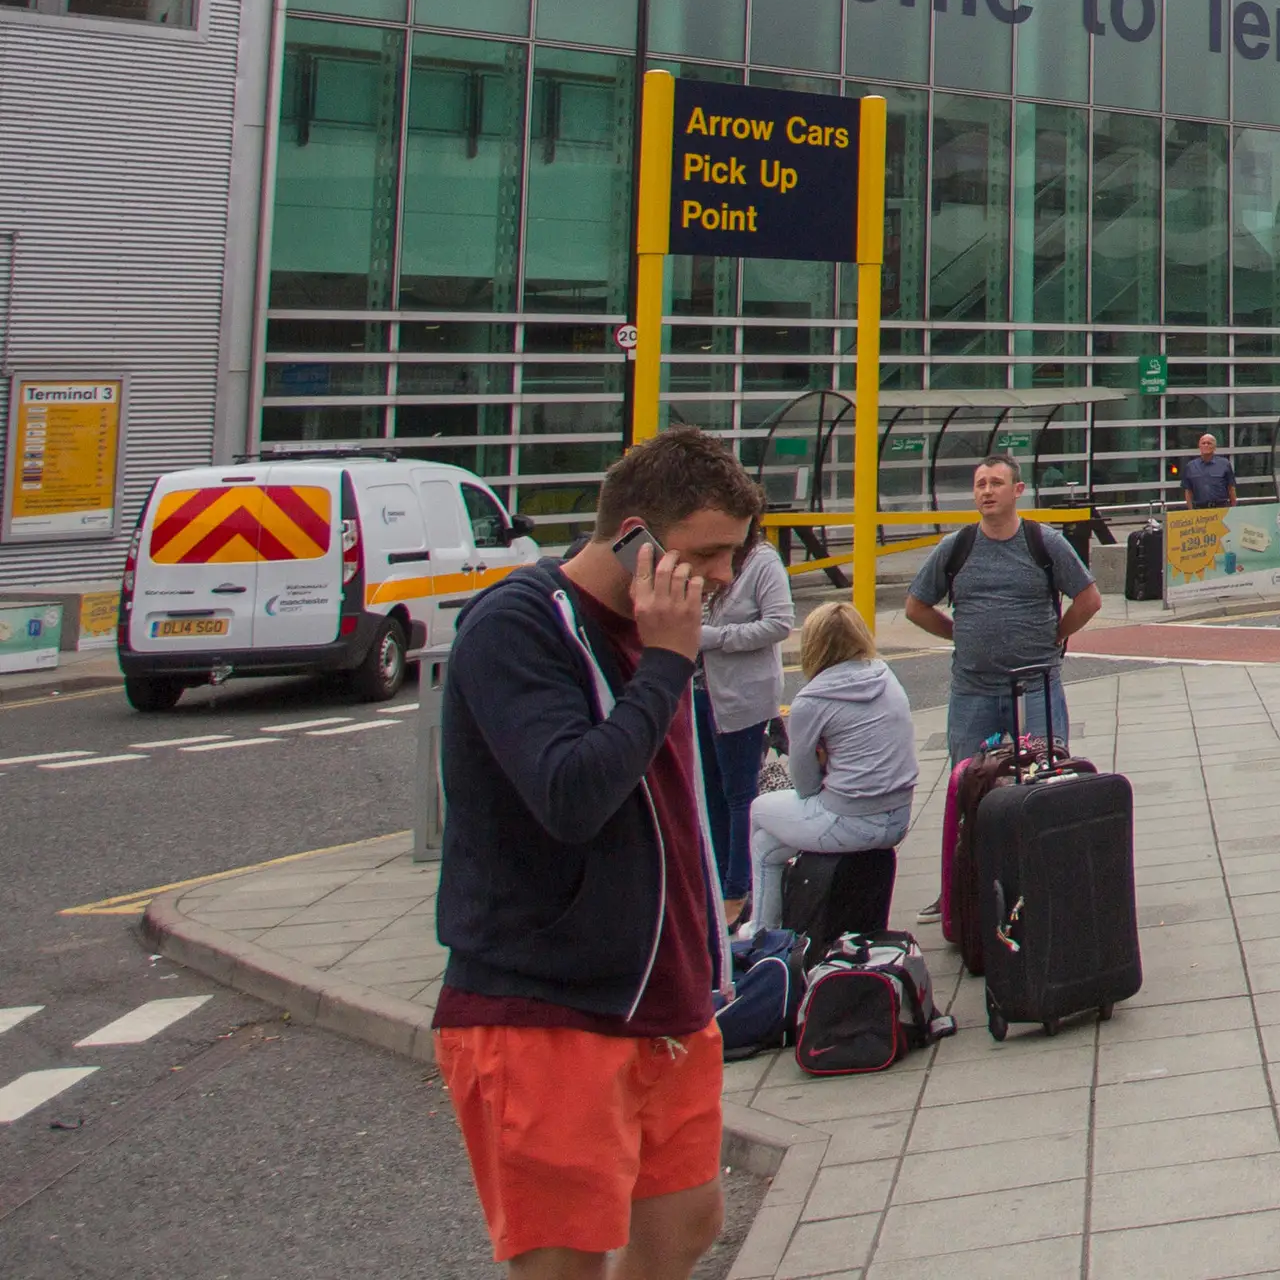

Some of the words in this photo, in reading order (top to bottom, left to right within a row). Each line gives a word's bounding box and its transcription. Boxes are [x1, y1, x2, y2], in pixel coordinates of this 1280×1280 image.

[686, 107, 774, 141] Arrow
[786, 116, 849, 148] Cars
[683, 153, 746, 185] Pick
[760, 159, 798, 194] Up
[681, 200, 758, 232] Point
[619, 330, 637, 341] 20
[28, 386, 98, 402] Terminal
[103, 387, 113, 400] 3
[163, 621, 191, 635] DL14
